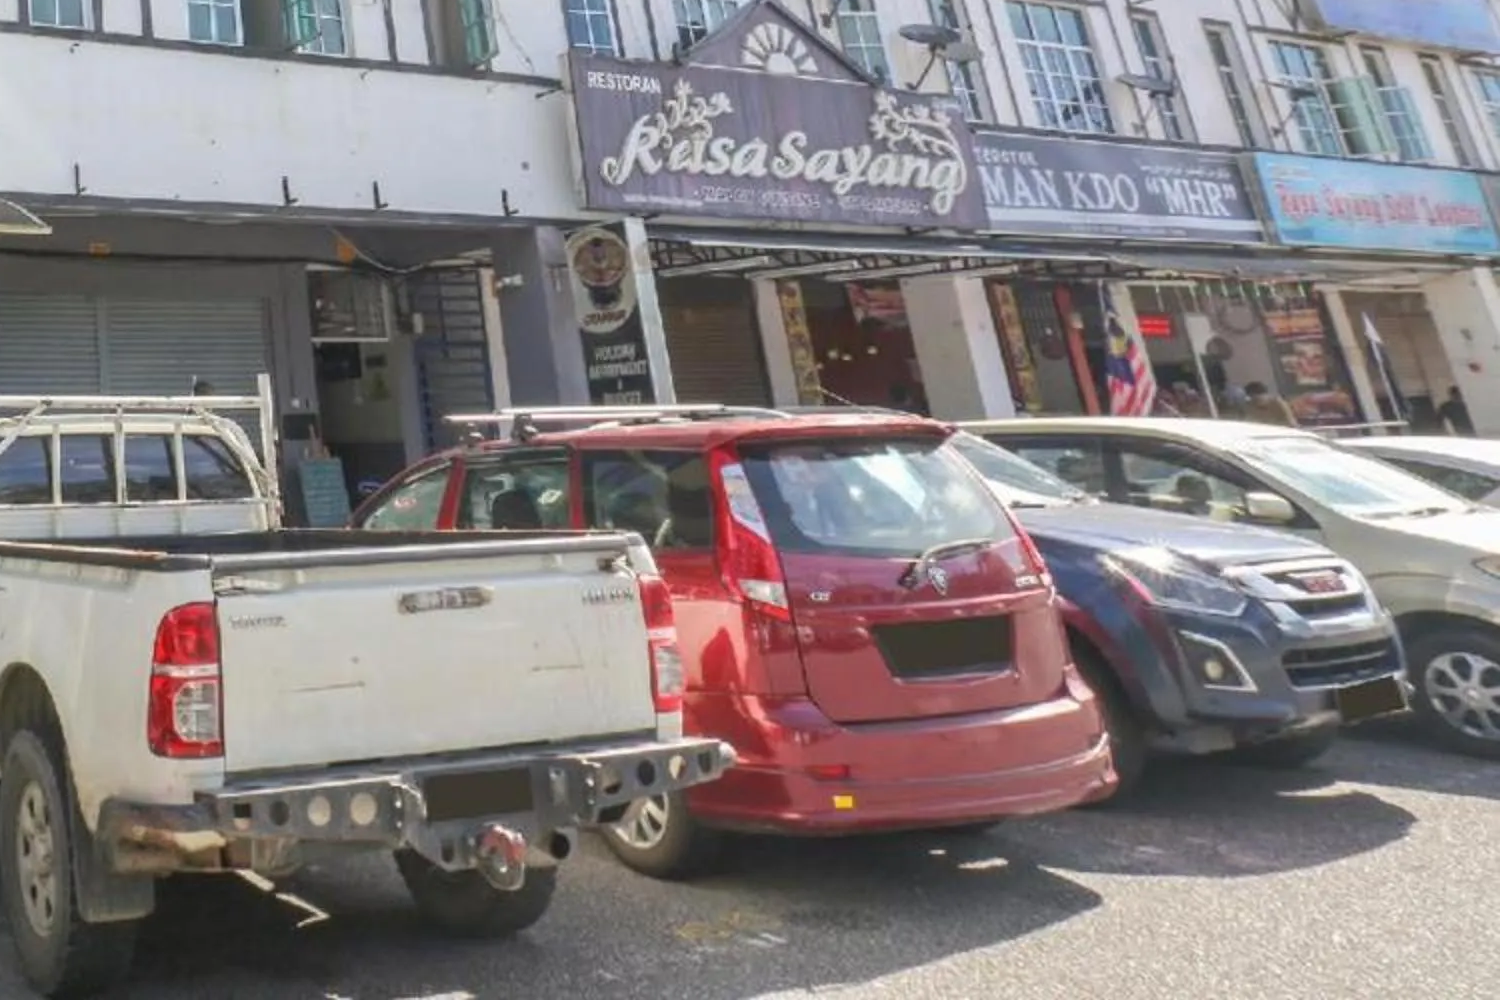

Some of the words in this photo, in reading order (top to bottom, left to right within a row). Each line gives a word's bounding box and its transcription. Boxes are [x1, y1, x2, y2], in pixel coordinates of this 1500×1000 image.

[587, 71, 663, 95] RESTORAN
[978, 165, 1062, 208] MAN
[1063, 169, 1141, 213] KDO
